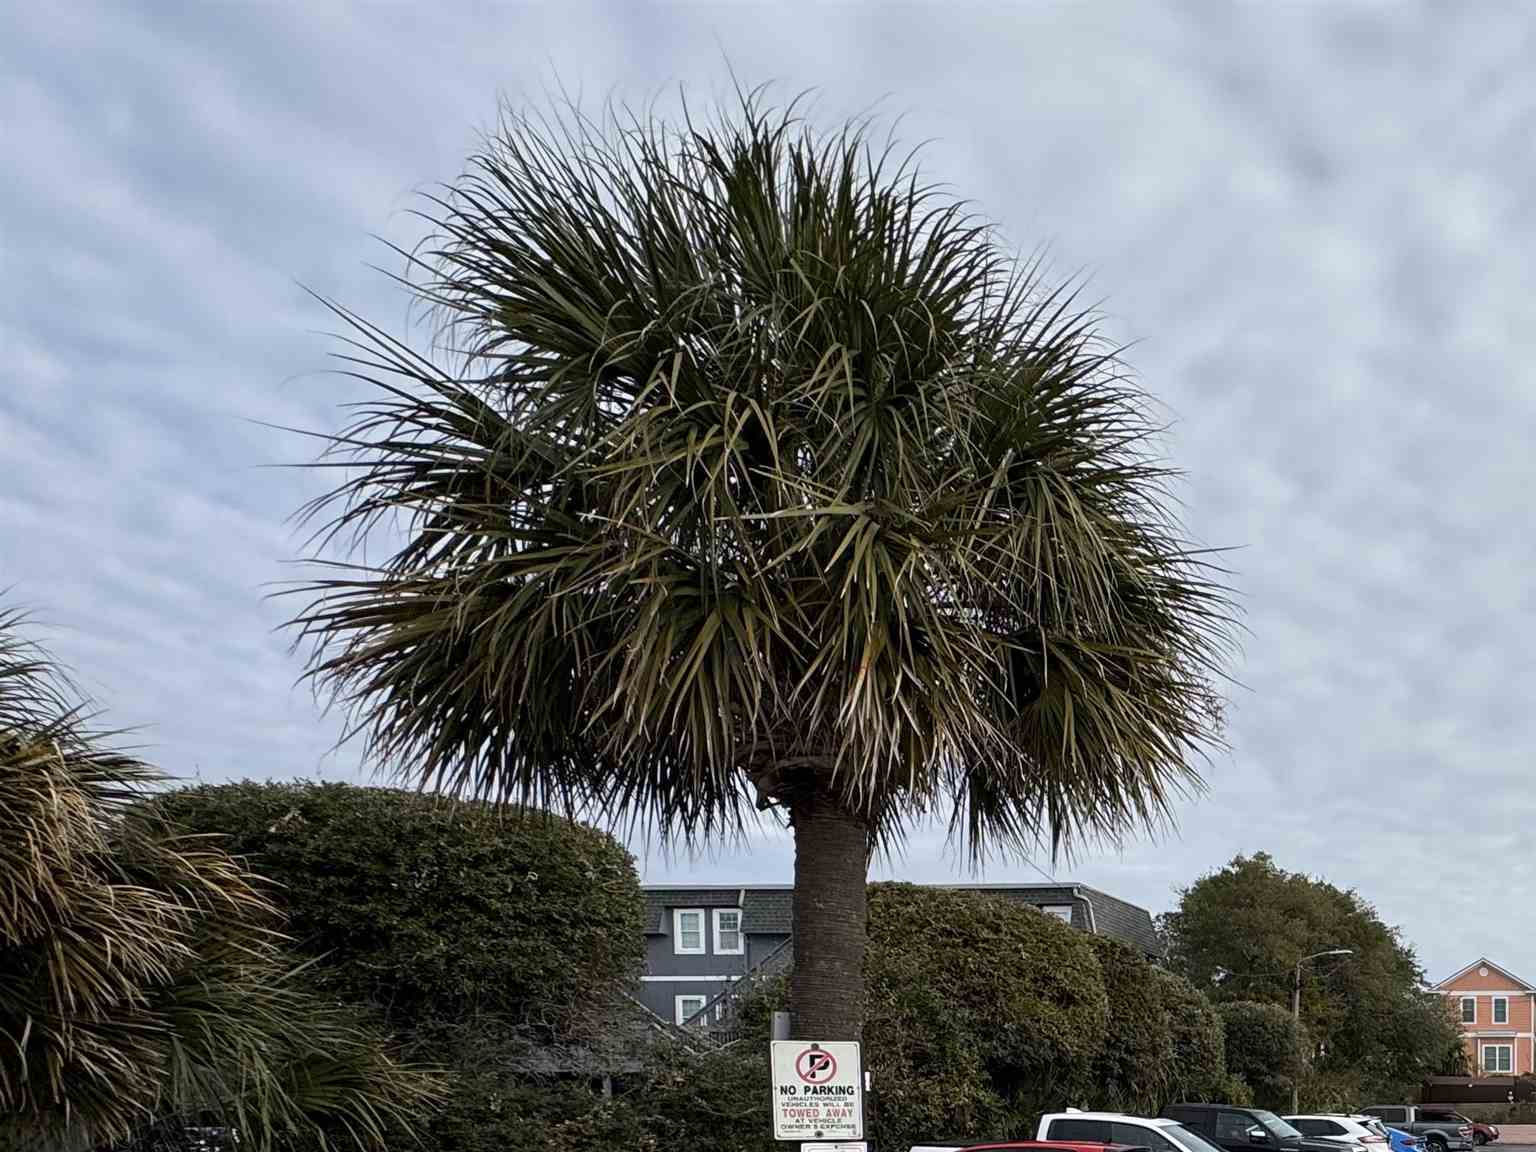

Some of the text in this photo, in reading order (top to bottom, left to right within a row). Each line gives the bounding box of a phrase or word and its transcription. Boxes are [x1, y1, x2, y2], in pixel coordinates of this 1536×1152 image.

[780, 1085, 855, 1096] NO PARKING
[782, 1108, 854, 1118] TOWED AWAY
